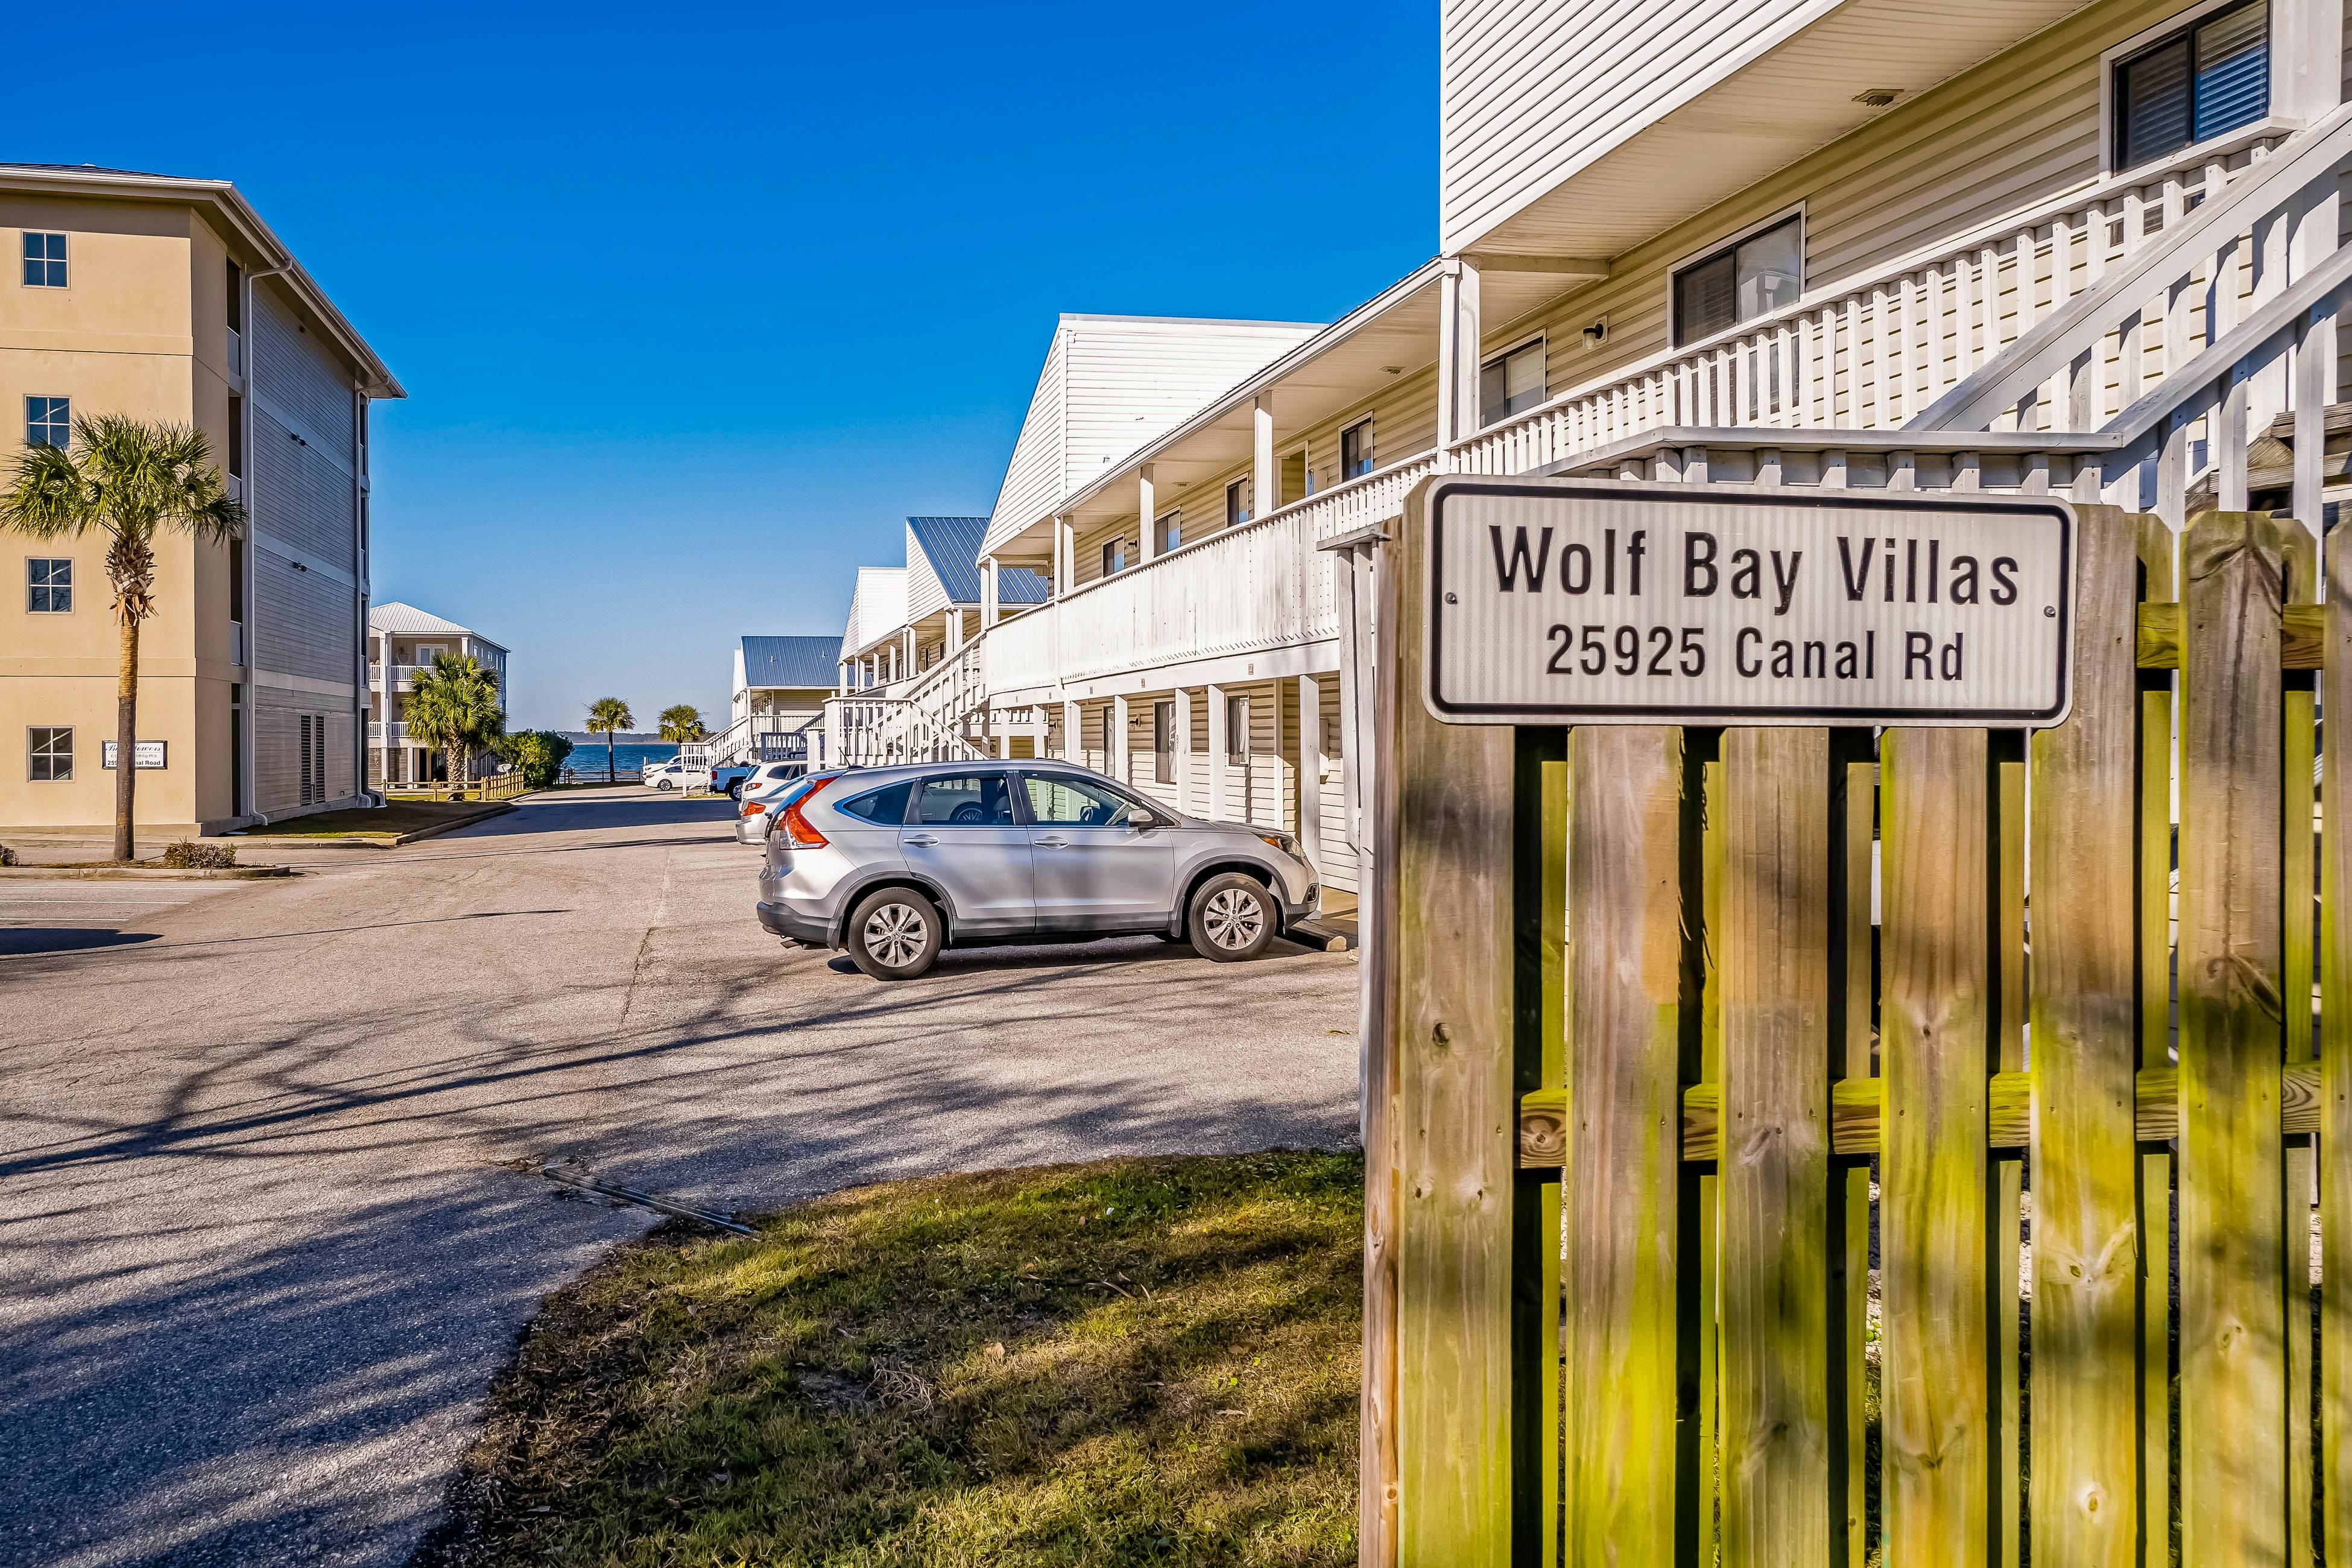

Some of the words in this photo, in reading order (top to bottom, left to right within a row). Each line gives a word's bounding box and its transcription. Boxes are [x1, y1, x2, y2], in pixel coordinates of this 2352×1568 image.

[1488, 524, 1646, 596] Wolf
[1683, 531, 1803, 616] Bay
[1836, 536, 2019, 606] Villas
[1545, 624, 1706, 678] 25925
[1735, 625, 1876, 680] Canal
[1904, 630, 1964, 681] Rd
